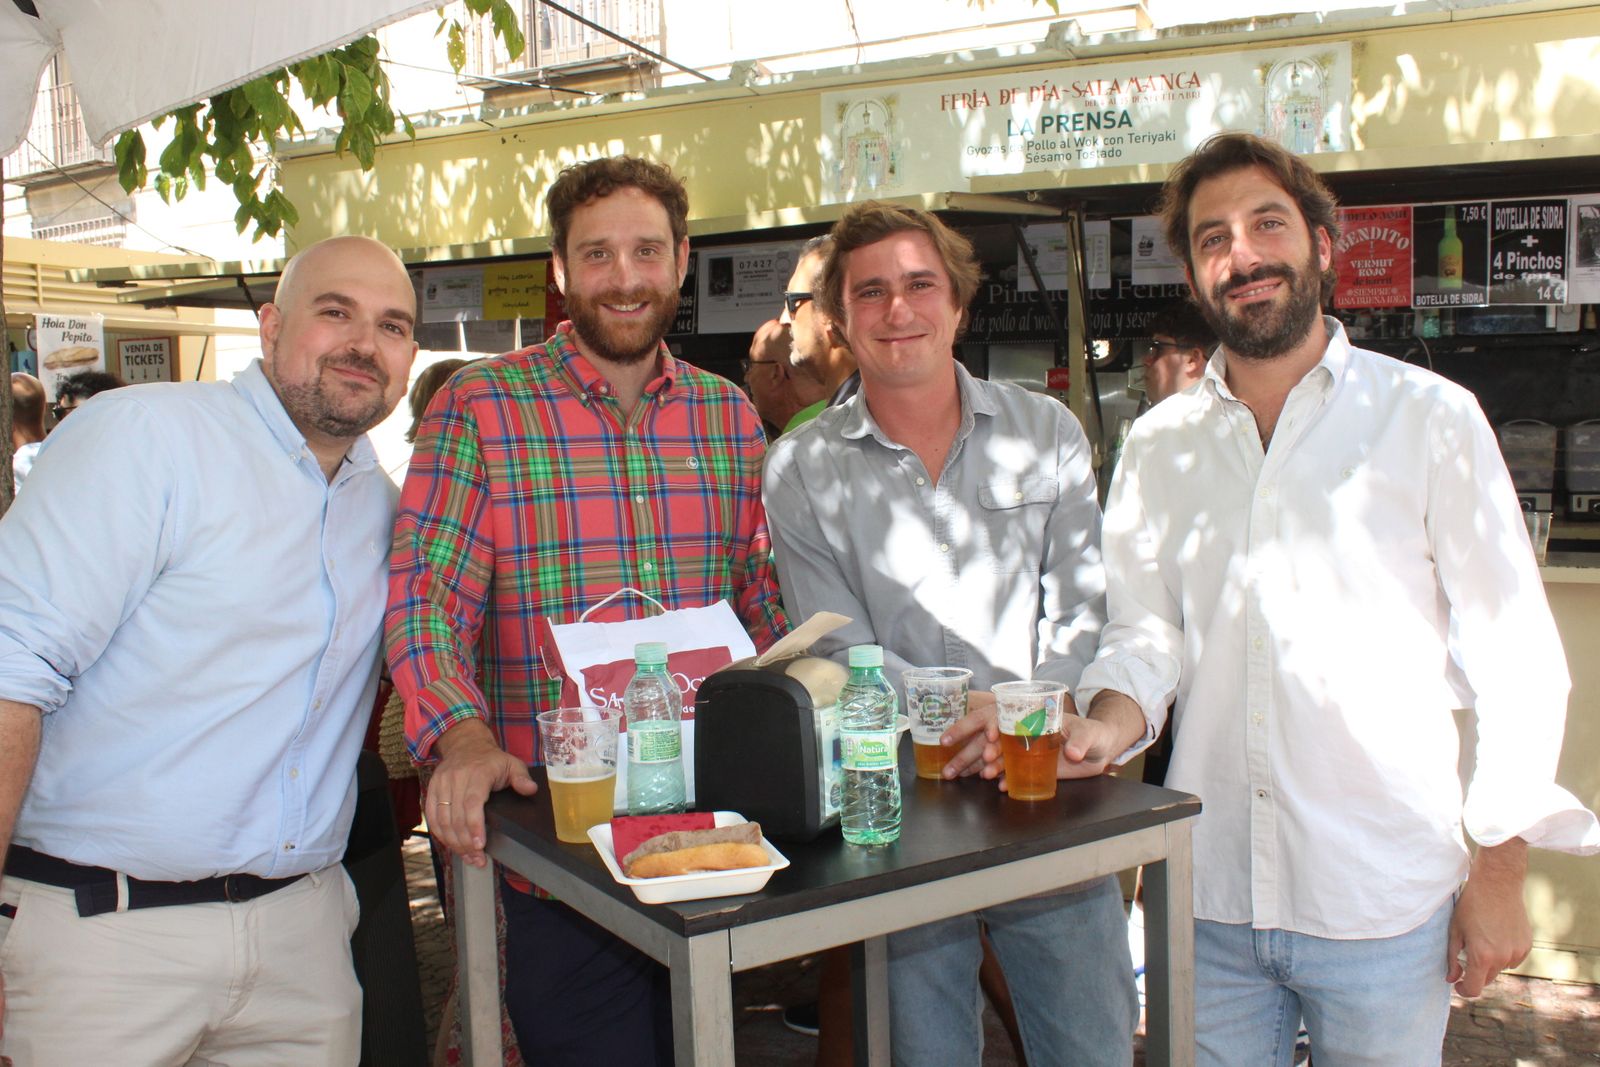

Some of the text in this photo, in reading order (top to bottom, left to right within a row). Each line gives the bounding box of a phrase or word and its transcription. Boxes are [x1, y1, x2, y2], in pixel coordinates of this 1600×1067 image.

[941, 89, 990, 111] FERIA
[1007, 110, 1133, 137] LA PRENSA
[967, 144, 1007, 158] Gyozas
[1027, 139, 1056, 151] Pollo
[1060, 139, 1071, 149] al
[1074, 136, 1099, 148] Wok
[1103, 136, 1124, 146] con
[1128, 130, 1176, 145] Teriyaki
[1025, 148, 1122, 164] Sésamo Tostado
[1462, 206, 1487, 224] 7,50 €
[1495, 205, 1564, 231] BOTELLA DE SIDRA
[1336, 226, 1410, 253] BENDITO
[739, 259, 773, 271] 07427
[1350, 258, 1395, 269] VERMUT
[1493, 251, 1563, 270] 4 Pinchos
[1358, 268, 1386, 277] ROJO
[1493, 271, 1516, 280] de
[1353, 287, 1392, 297] SIEMPRE
[1415, 292, 1485, 306] BOTELLA DE SIDRA
[1537, 285, 1564, 300] 14 €
[41, 317, 87, 330] Hola Don
[971, 309, 985, 333] de
[985, 307, 1016, 341] pollo
[1018, 307, 1033, 332] al
[1115, 311, 1124, 337] y
[124, 343, 163, 353] VENTA DE
[125, 353, 165, 366] TICKETS
